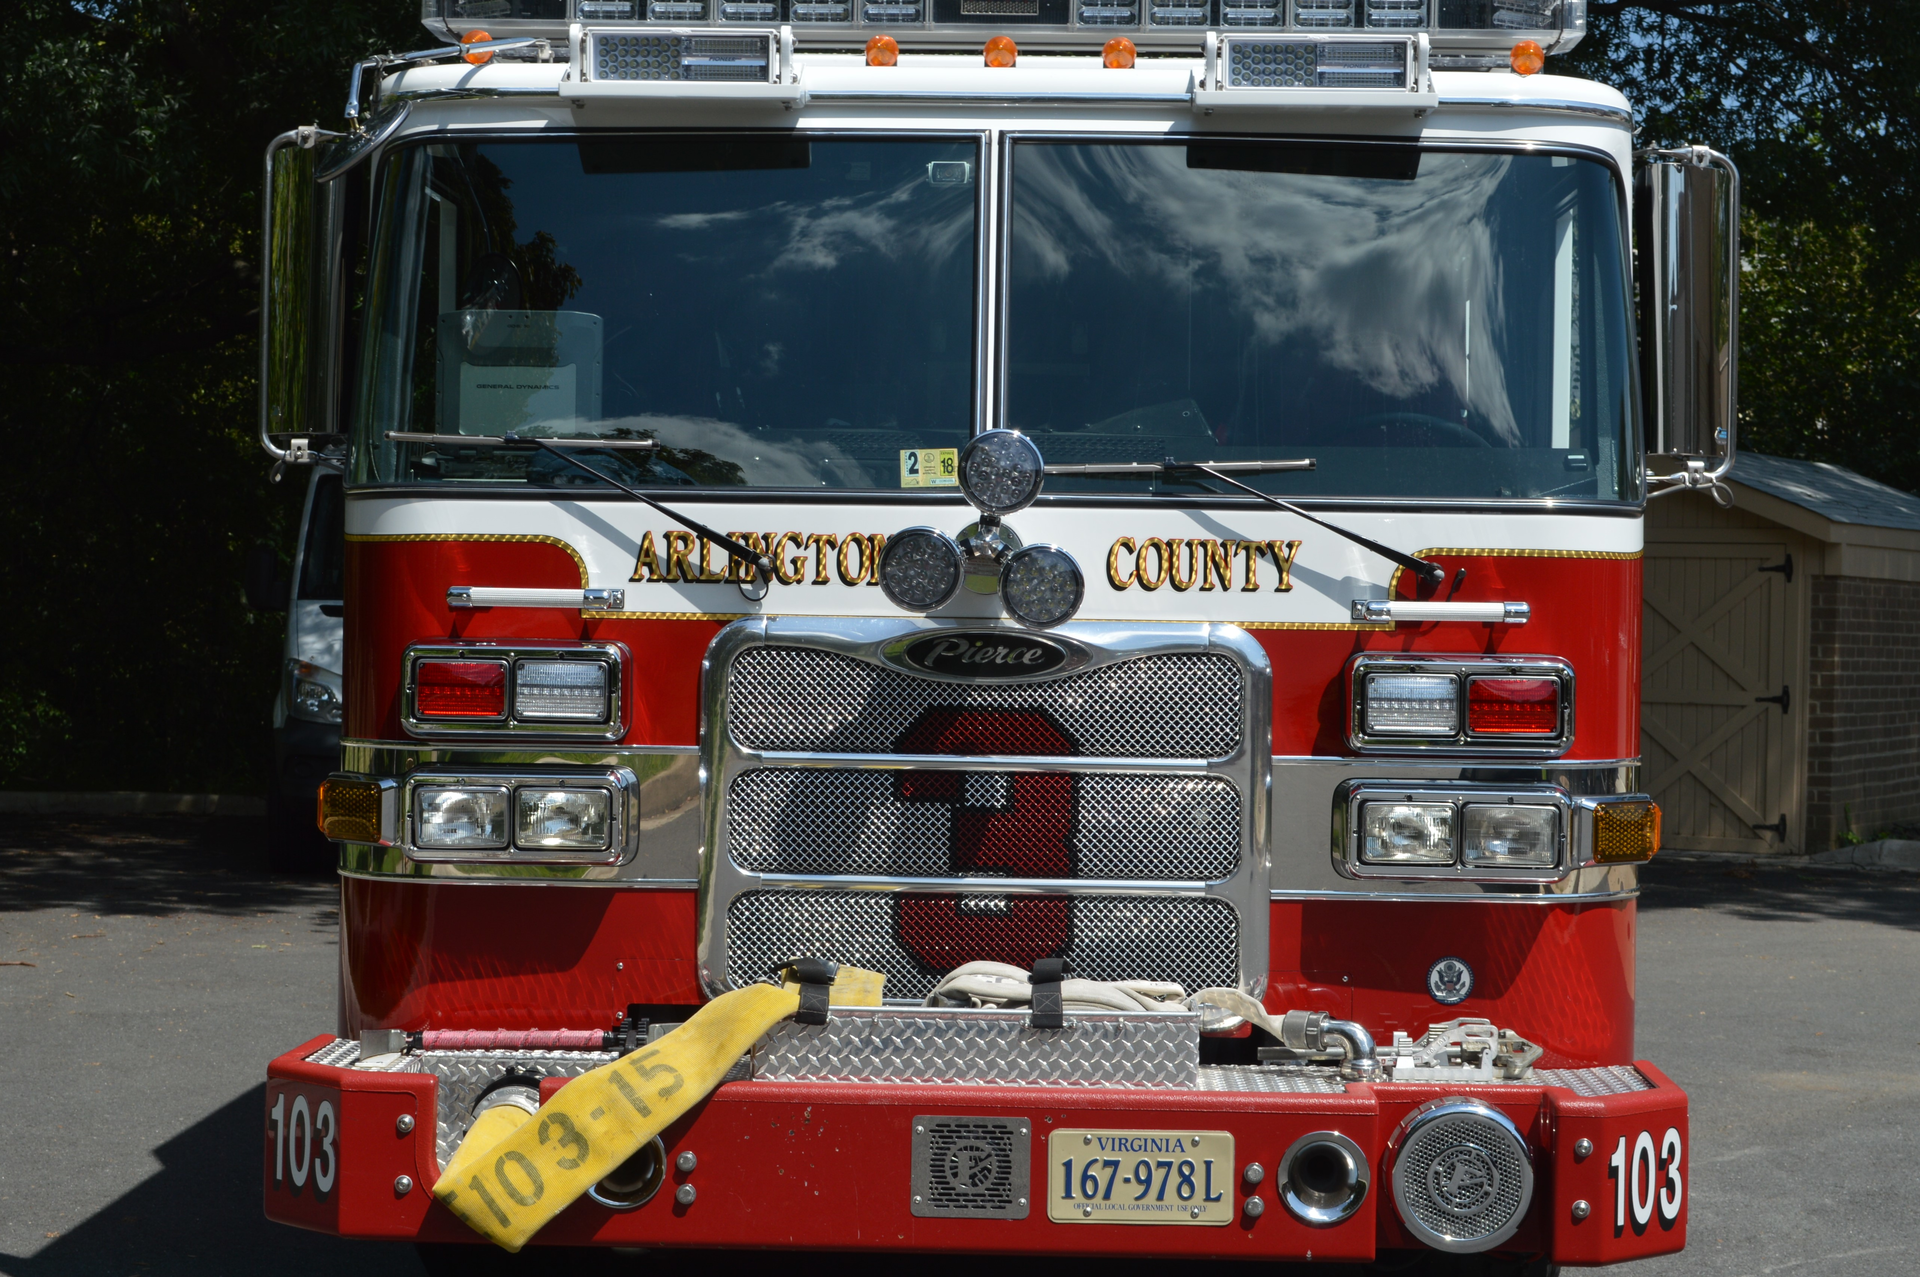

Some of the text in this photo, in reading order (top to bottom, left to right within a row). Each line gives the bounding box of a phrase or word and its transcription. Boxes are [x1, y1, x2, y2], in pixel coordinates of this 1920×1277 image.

[908, 451, 919, 475] 2
[941, 457, 954, 474] 18
[1106, 536, 1303, 593] COUNTY
[924, 637, 1045, 667] Pierce
[268, 1092, 336, 1200] 103
[1097, 1137, 1187, 1153] VIRGINIA
[1608, 1126, 1683, 1236] 103
[1104, 1203, 1127, 1211] LOCAL
[1128, 1204, 1174, 1212] GOVERNMENT
